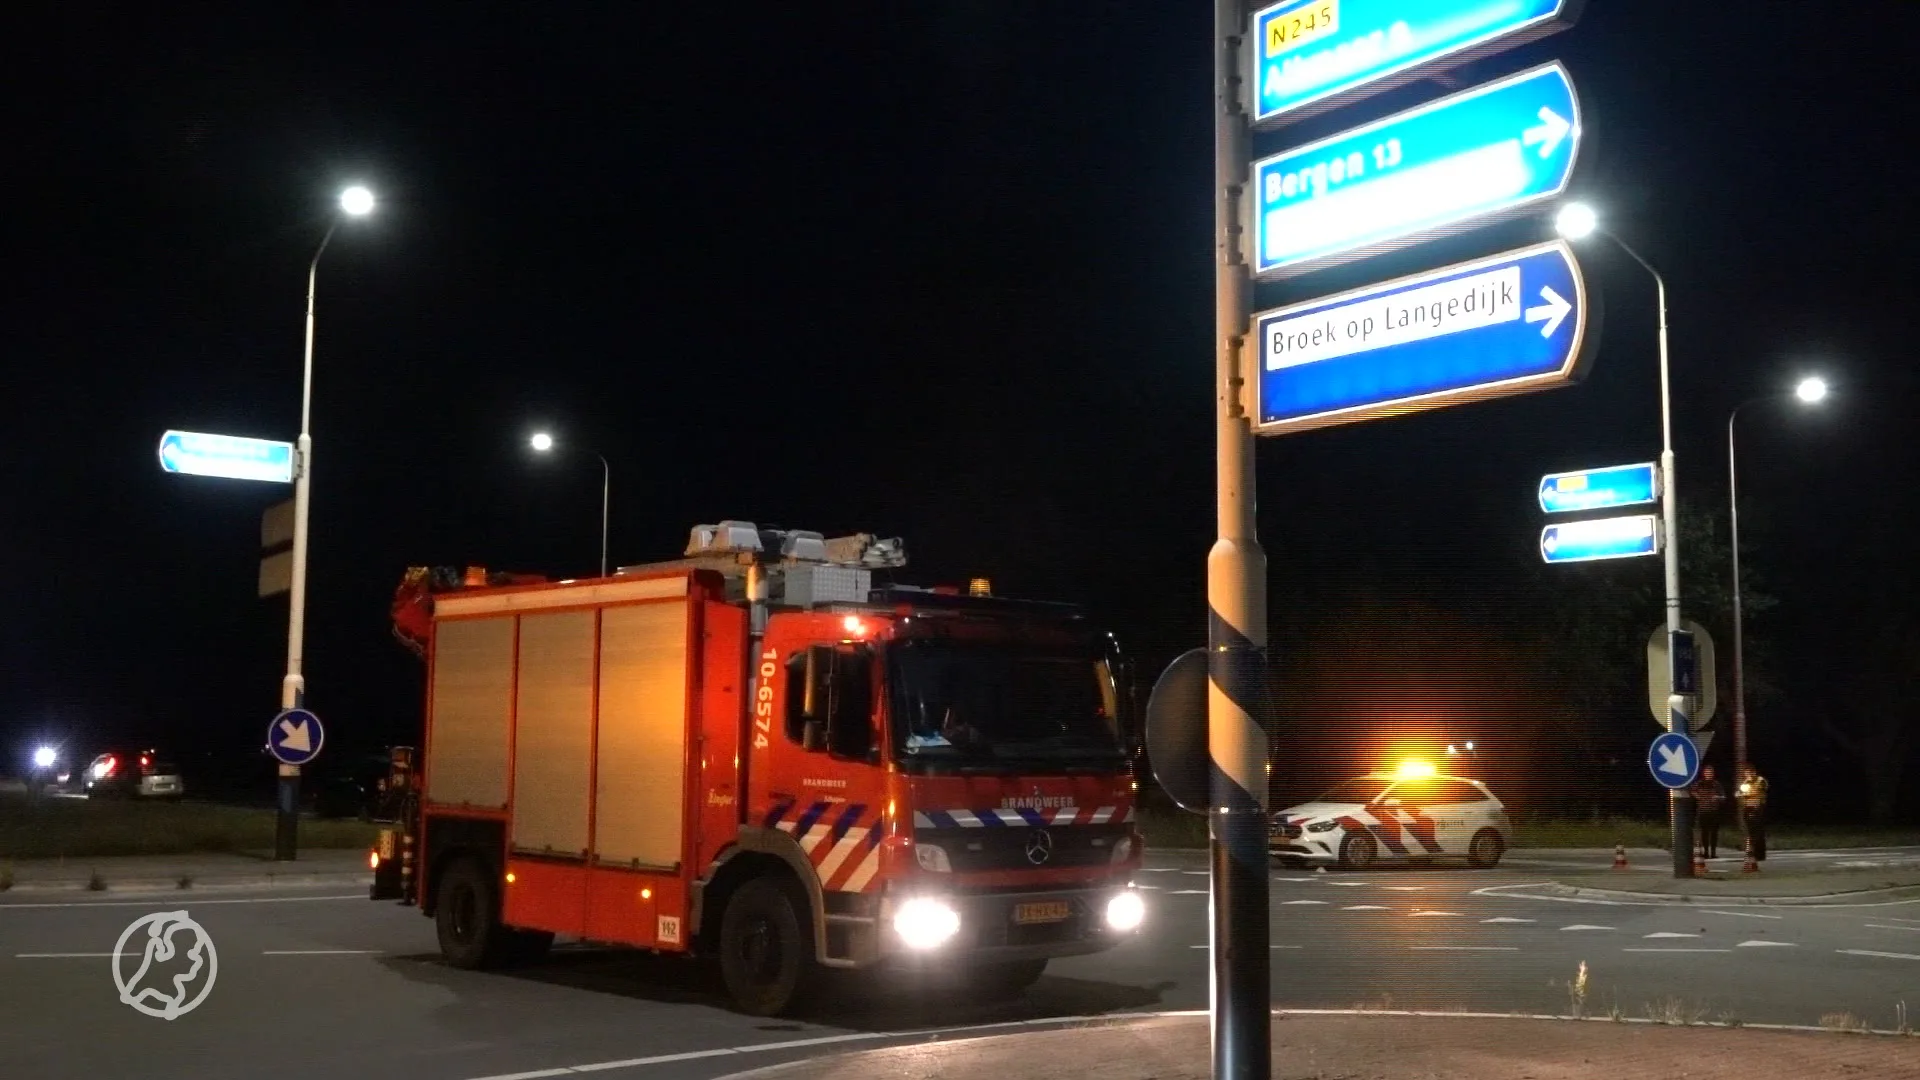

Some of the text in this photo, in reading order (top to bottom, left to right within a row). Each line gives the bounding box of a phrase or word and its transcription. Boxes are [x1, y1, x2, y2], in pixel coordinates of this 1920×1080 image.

[1272, 6, 1331, 46] N245
[1265, 137, 1403, 204] Bergen 13
[1273, 280, 1513, 355] Broek op Langedijk
[754, 647, 777, 749] 10-6574
[1000, 796, 1074, 810] BRANDWEER
